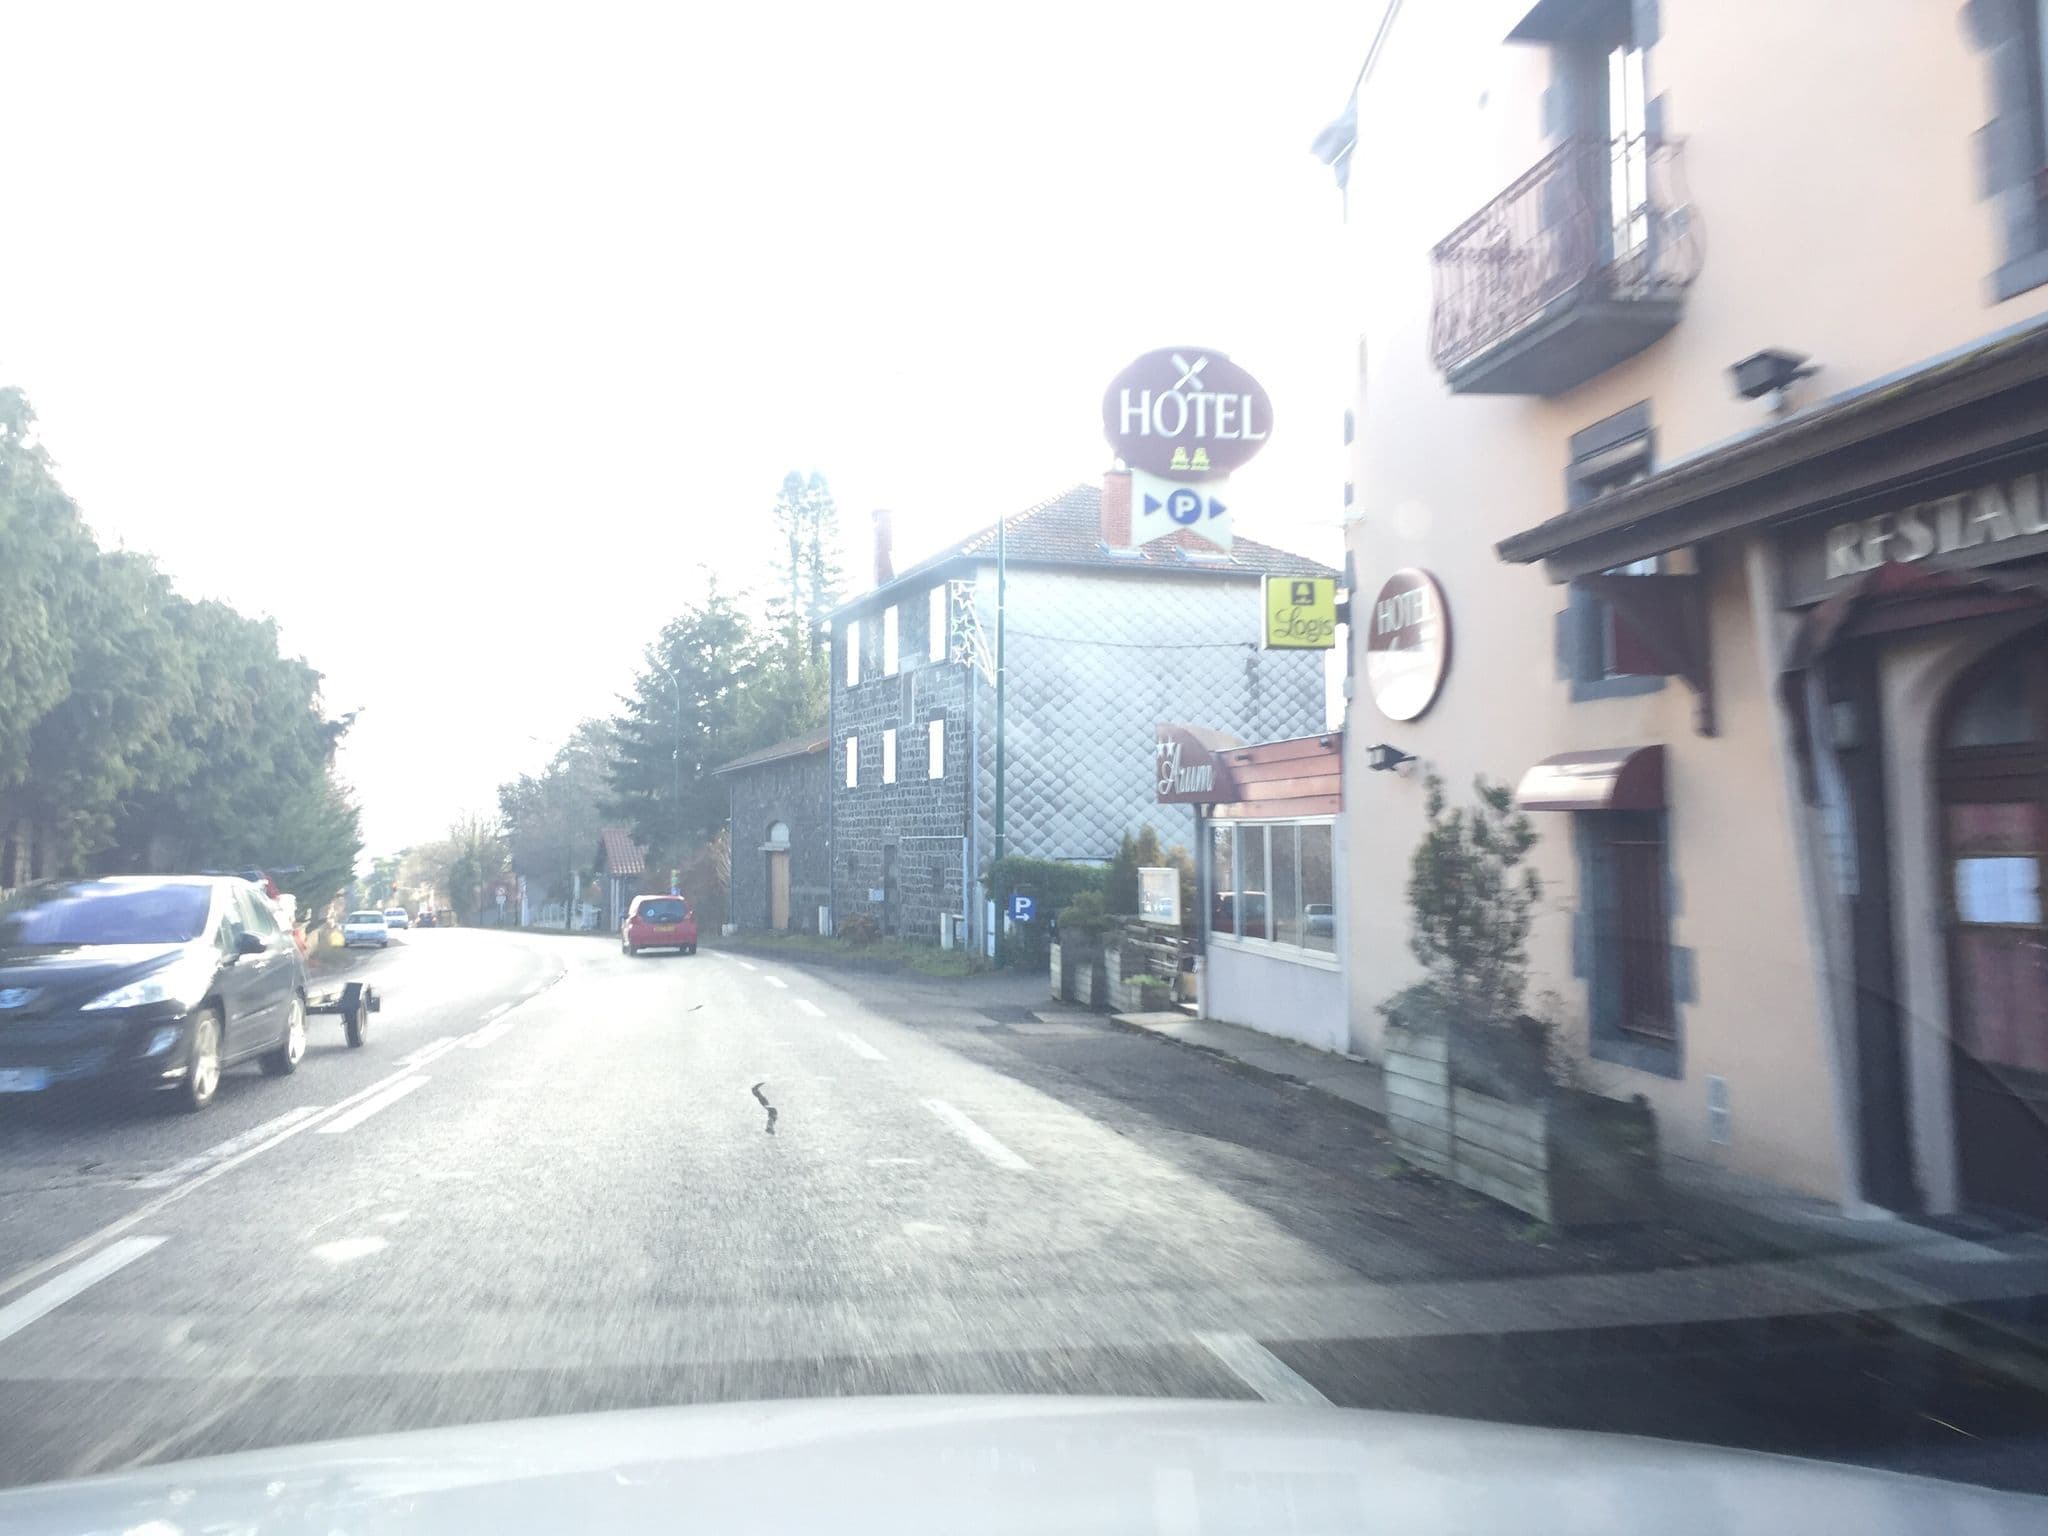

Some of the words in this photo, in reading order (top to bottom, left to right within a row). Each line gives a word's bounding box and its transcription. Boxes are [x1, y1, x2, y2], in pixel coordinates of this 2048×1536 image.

[1120, 388, 1266, 440] HOTEL
[1174, 495, 1195, 518] P
[1015, 897, 1032, 913] P
